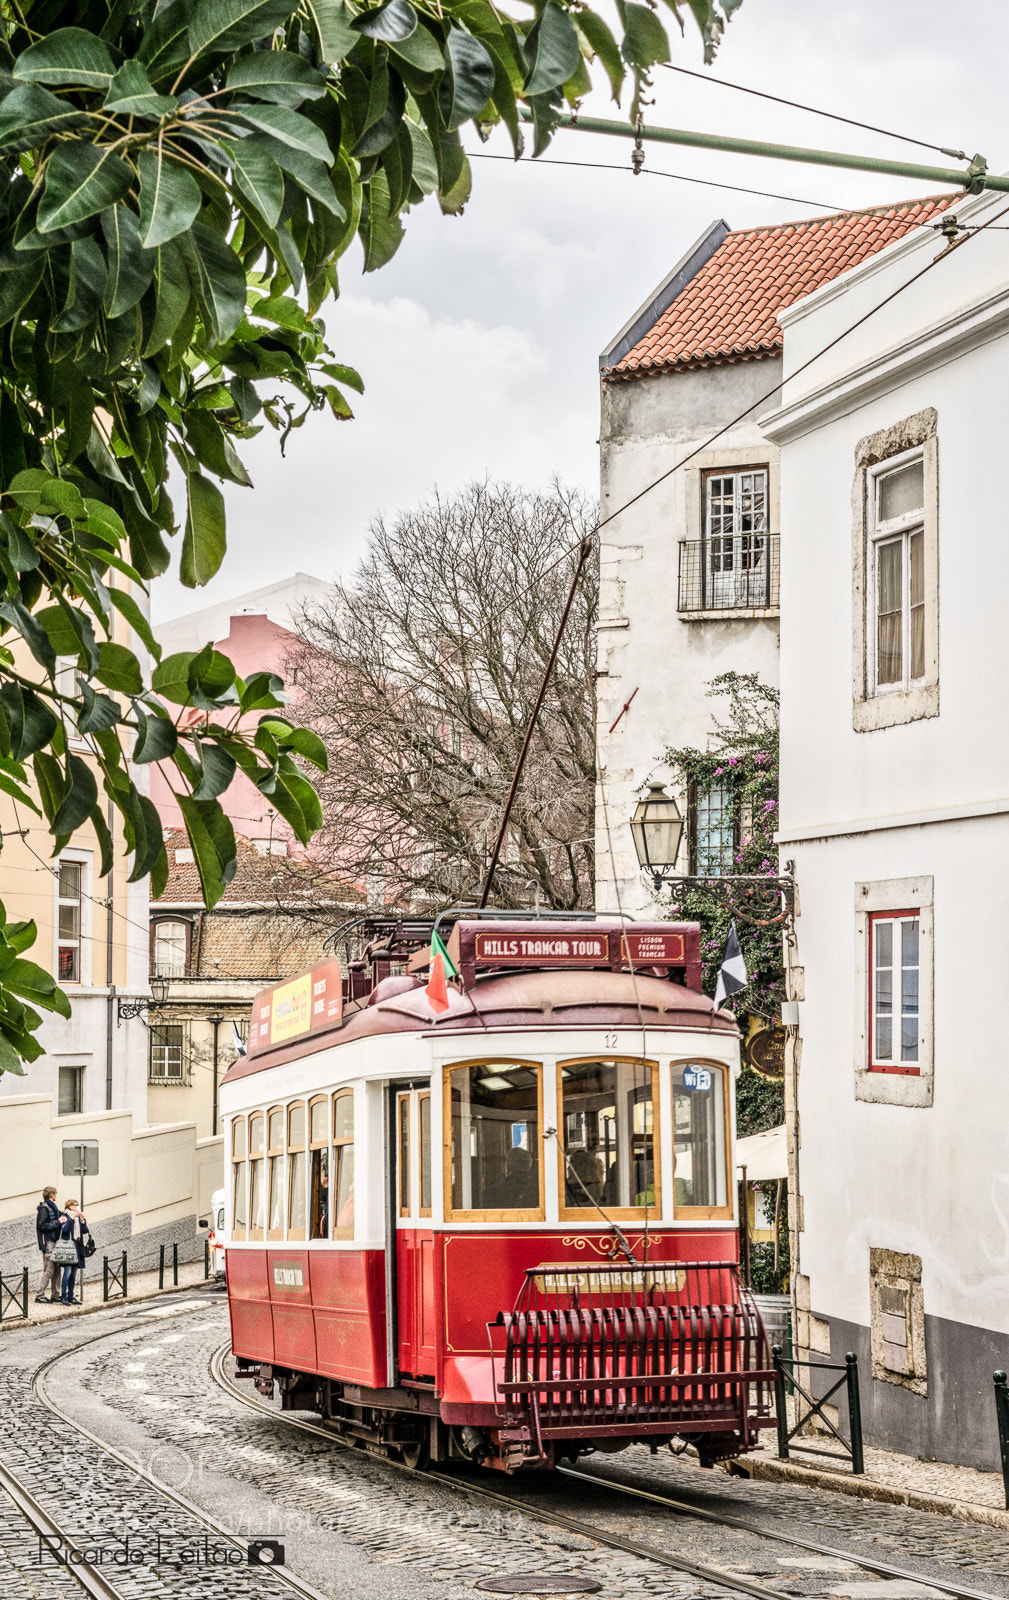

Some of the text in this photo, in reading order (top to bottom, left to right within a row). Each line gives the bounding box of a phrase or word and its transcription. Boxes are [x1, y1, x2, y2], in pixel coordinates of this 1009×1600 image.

[484, 940, 602, 956] HILLS TRAMCAR TOUR
[604, 1034, 618, 1049] 12
[544, 1273, 586, 1287] HILLS
